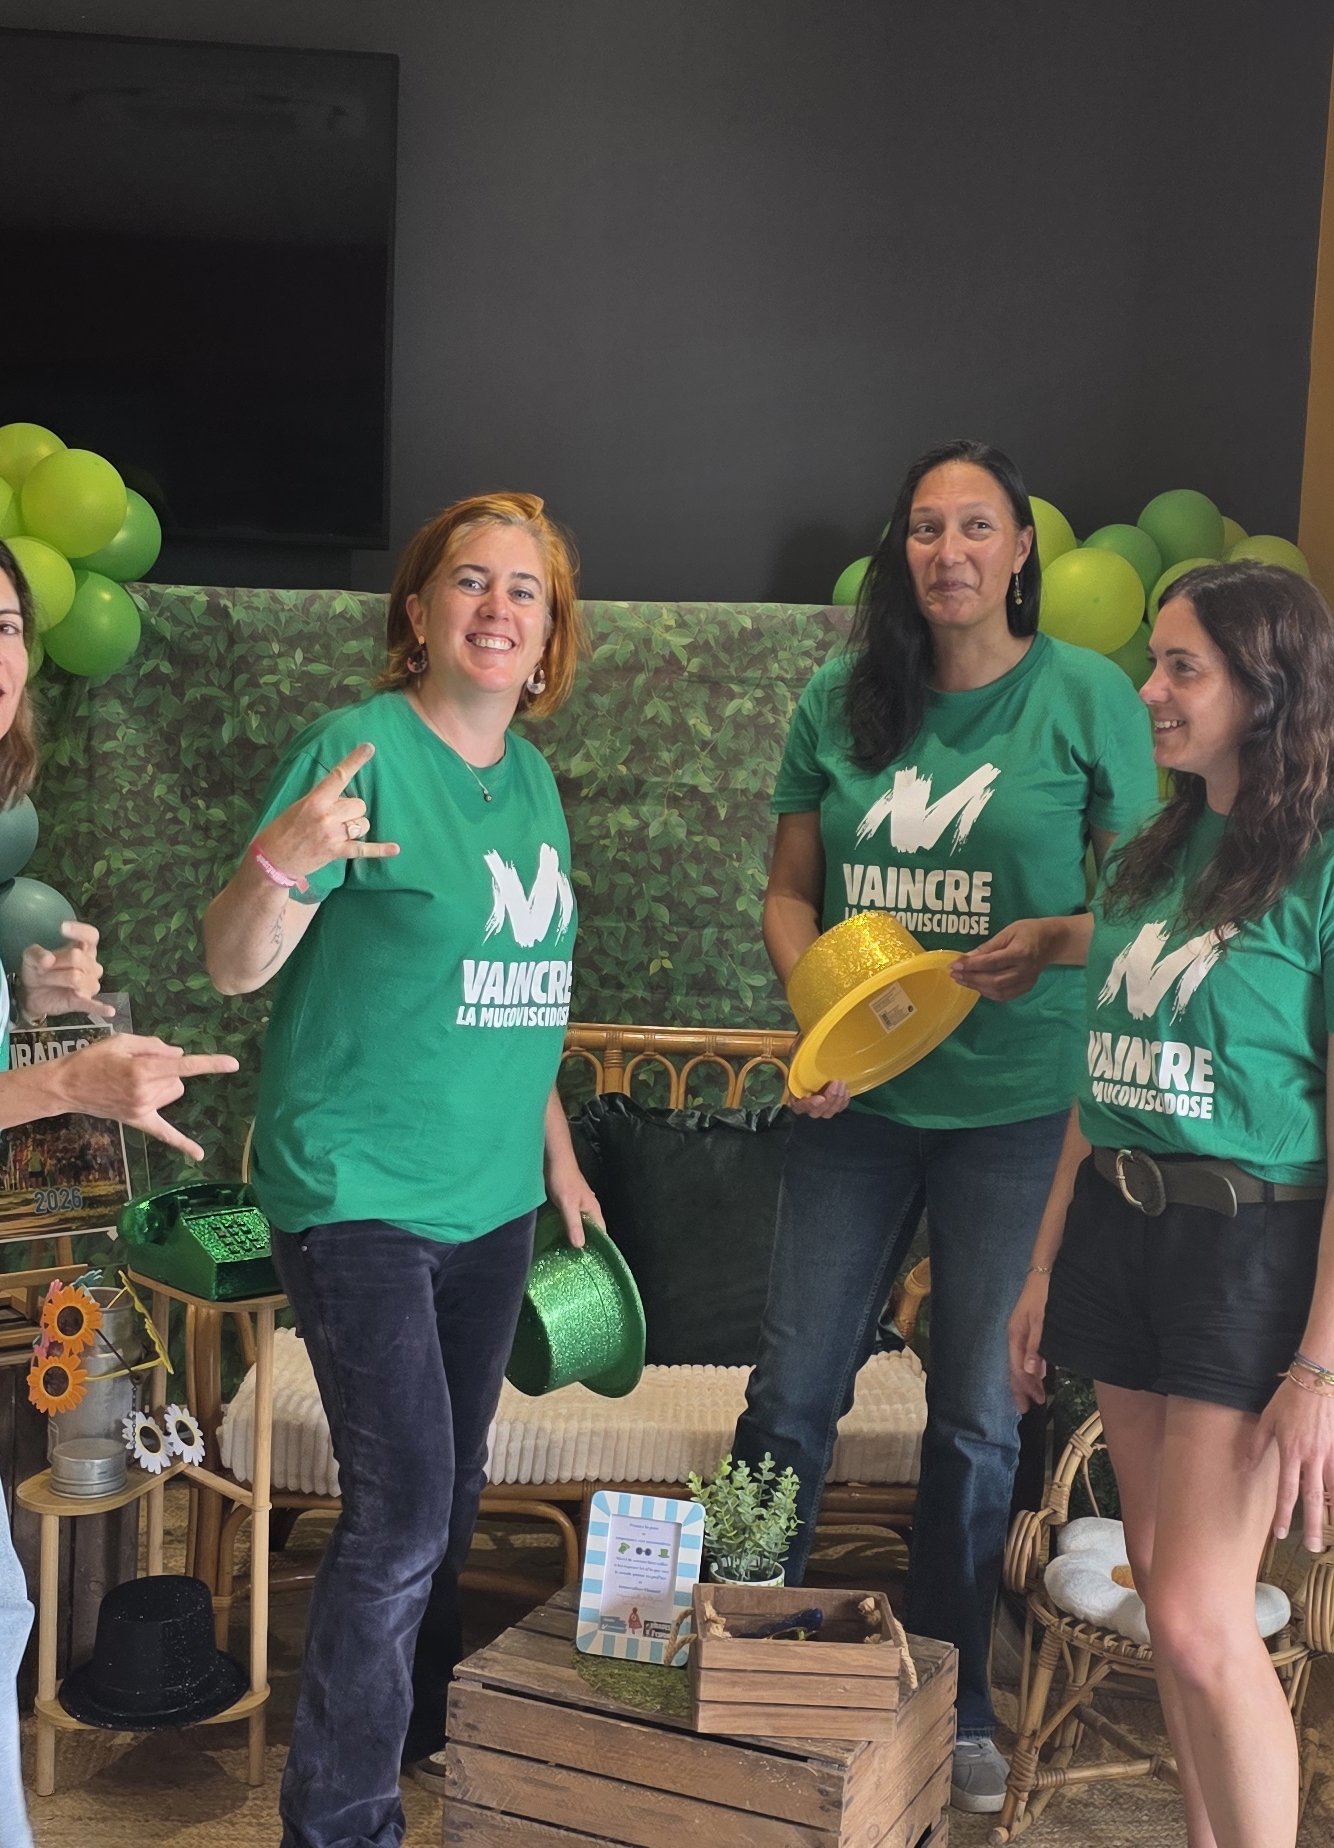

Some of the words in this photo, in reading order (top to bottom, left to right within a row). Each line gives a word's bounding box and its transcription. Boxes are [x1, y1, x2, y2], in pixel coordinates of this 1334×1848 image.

[843, 863, 993, 913] VAINCRE
[456, 1006, 476, 1026] LA
[479, 1006, 569, 1028] MUCOVISCIDOS
[1087, 1030, 1215, 1094] VAINCRE
[1092, 1081, 1213, 1120] MUCOVISCIDOSE
[34, 1187, 83, 1214] 2026
